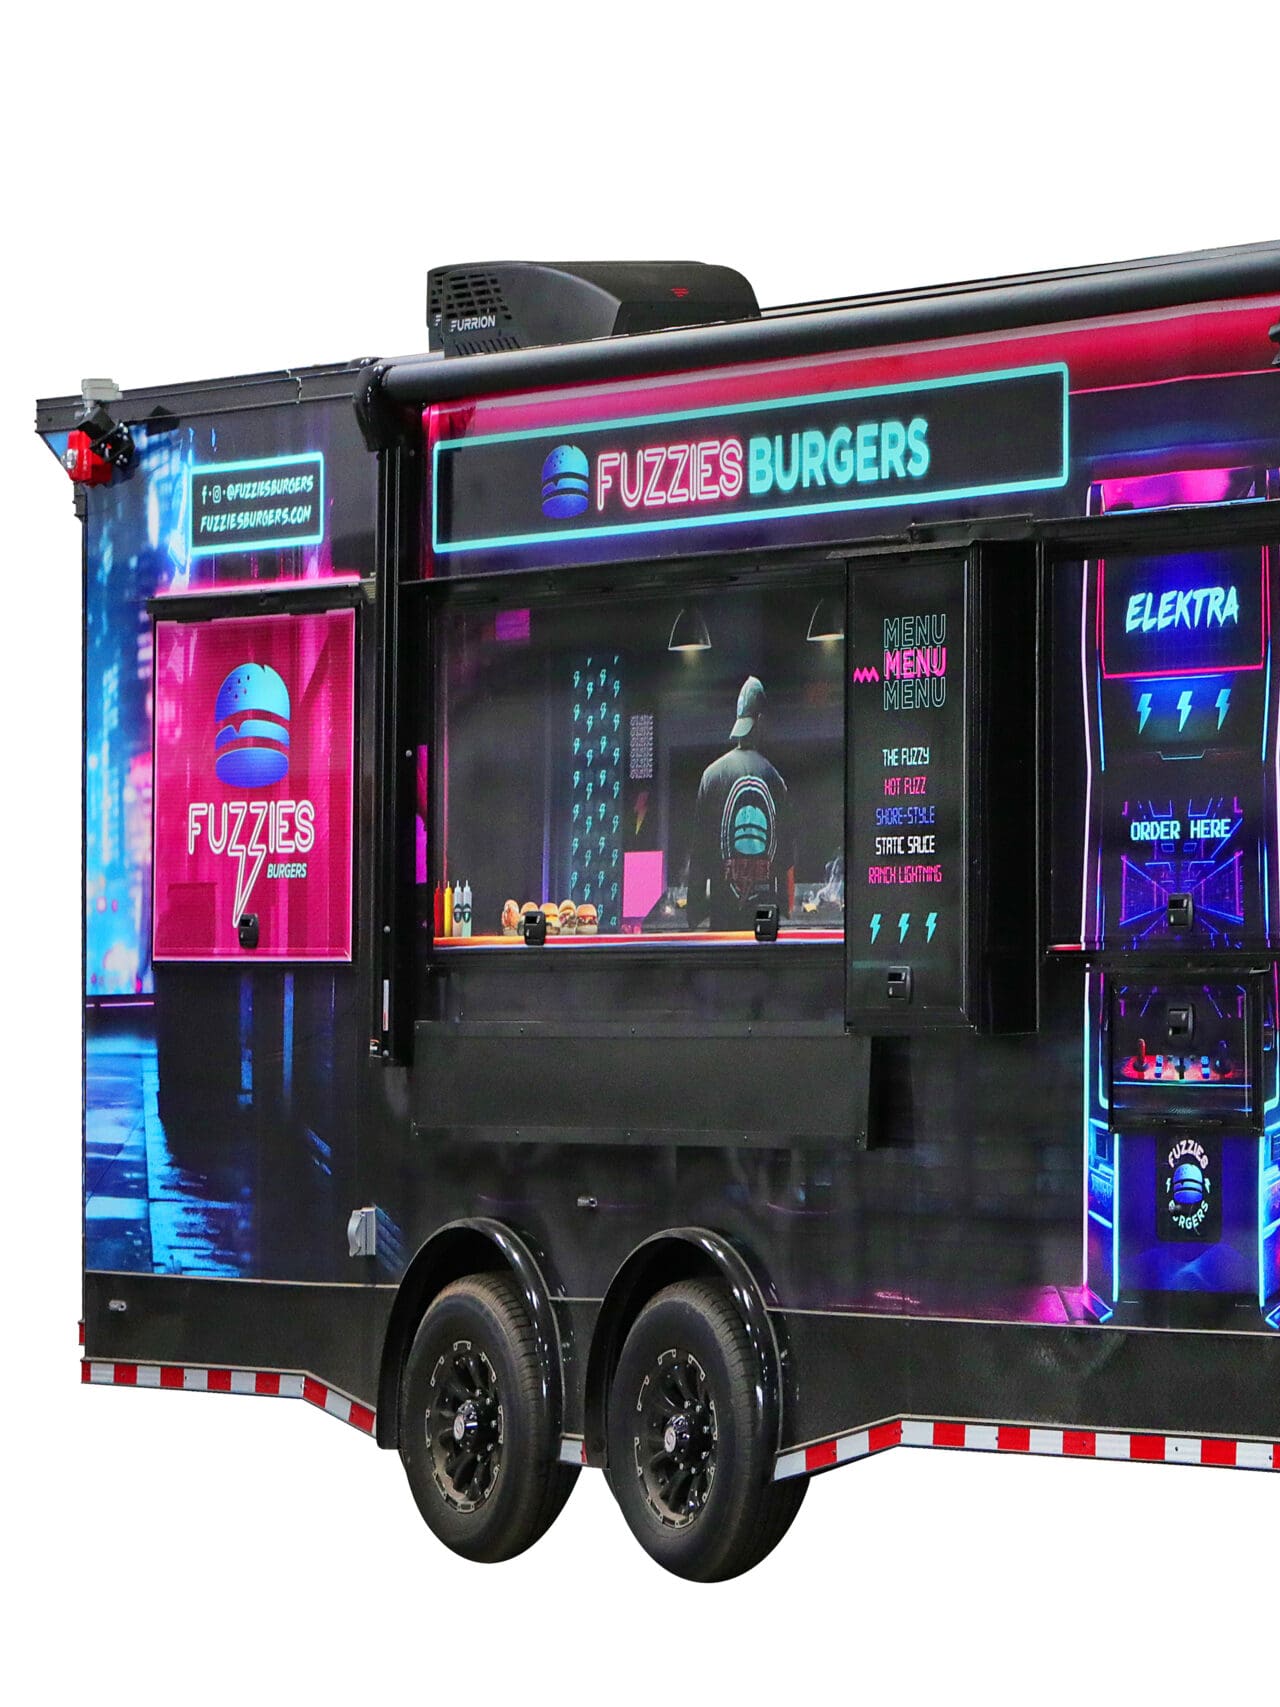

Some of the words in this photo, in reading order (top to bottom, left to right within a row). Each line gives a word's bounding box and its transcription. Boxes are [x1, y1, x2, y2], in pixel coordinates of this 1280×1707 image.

[449, 315, 496, 332] FURRION
[597, 438, 743, 511] FUZZIES
[749, 418, 929, 495] BURGERS
[226, 475, 314, 501] @FUZZIESBURGERS
[200, 505, 312, 533] FUZZIESBURGERS.COM
[1126, 586, 1239, 633] ELEKTRA
[884, 614, 946, 648] MENU
[884, 646, 947, 680] MENU
[884, 677, 946, 710] MENU
[882, 749, 899, 767] THE
[901, 747, 930, 765] FUZZY
[884, 778, 901, 796] HOT
[904, 776, 928, 795] FUZZ
[188, 800, 315, 858] FUZZIES
[875, 806, 935, 826] SHORE-STYLE
[1130, 820, 1181, 840] ORDER
[1189, 819, 1231, 839] HERE
[875, 837, 905, 855] STATIC
[907, 835, 936, 854] SAUCE
[267, 863, 308, 879] BURGERS
[868, 866, 897, 885] RANCH
[899, 864, 943, 884] LIGHTNING
[1168, 1140, 1209, 1170] FUZZIES
